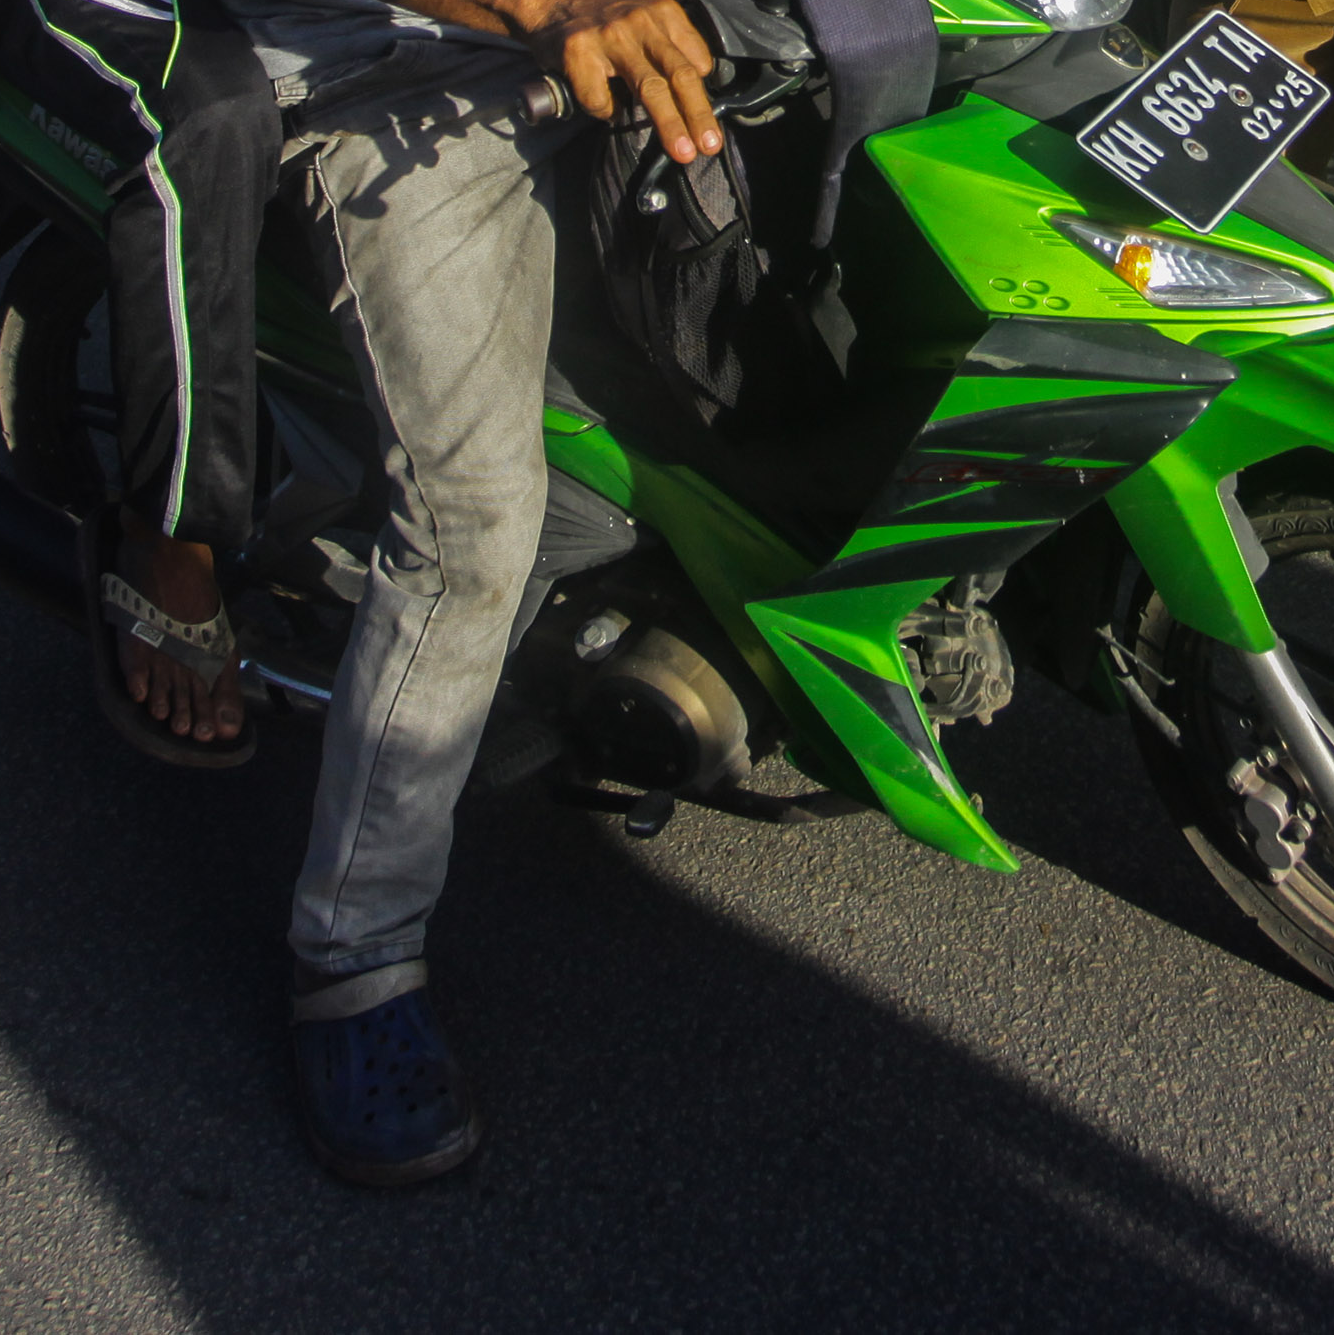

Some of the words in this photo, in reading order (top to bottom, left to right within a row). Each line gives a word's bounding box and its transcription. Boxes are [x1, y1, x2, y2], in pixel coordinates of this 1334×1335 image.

[1091, 119, 1165, 181] KH
[1141, 57, 1229, 136] 6634
[1202, 25, 1266, 73] TA
